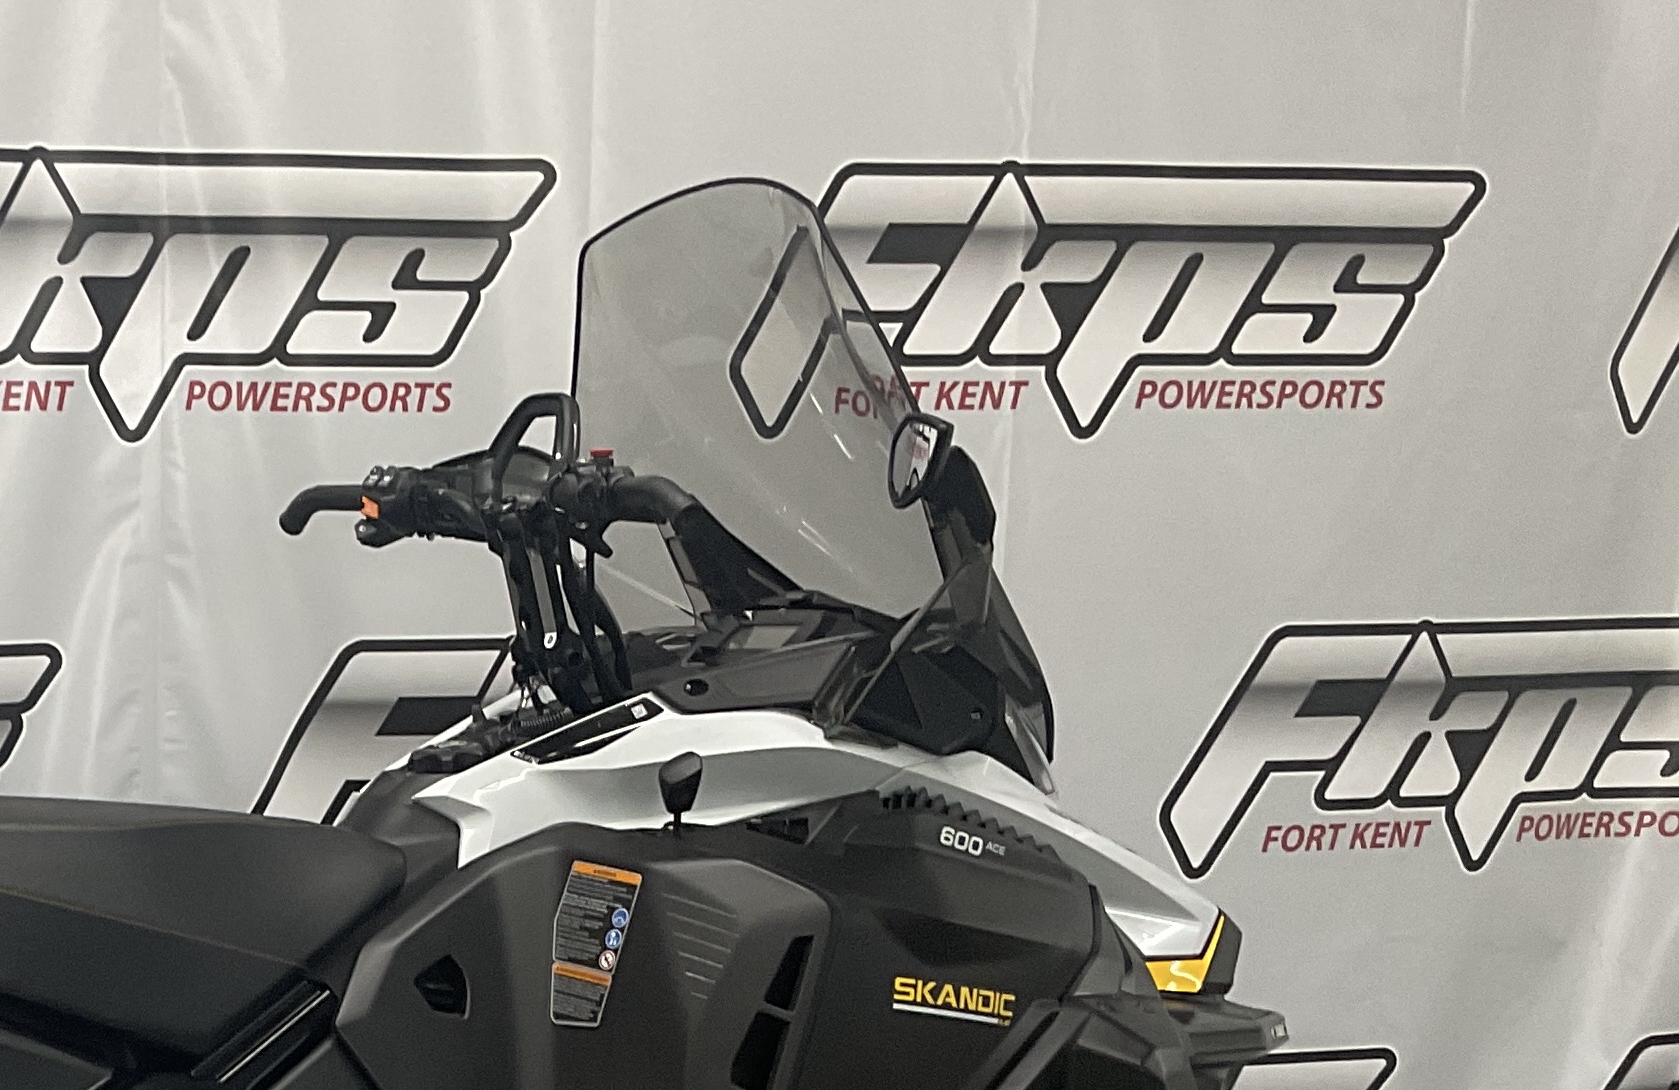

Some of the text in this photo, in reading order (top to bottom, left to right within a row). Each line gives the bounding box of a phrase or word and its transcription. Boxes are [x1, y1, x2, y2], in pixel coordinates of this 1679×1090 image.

[185, 380, 452, 413] POWERSPORTS
[934, 380, 1030, 411] KENT
[1136, 379, 1385, 409] POWERSPORTS
[940, 825, 1006, 856] 600 ACE
[1262, 811, 1679, 853] FORT KENT POWERSPO
[893, 976, 1016, 1017] SKANDIC
